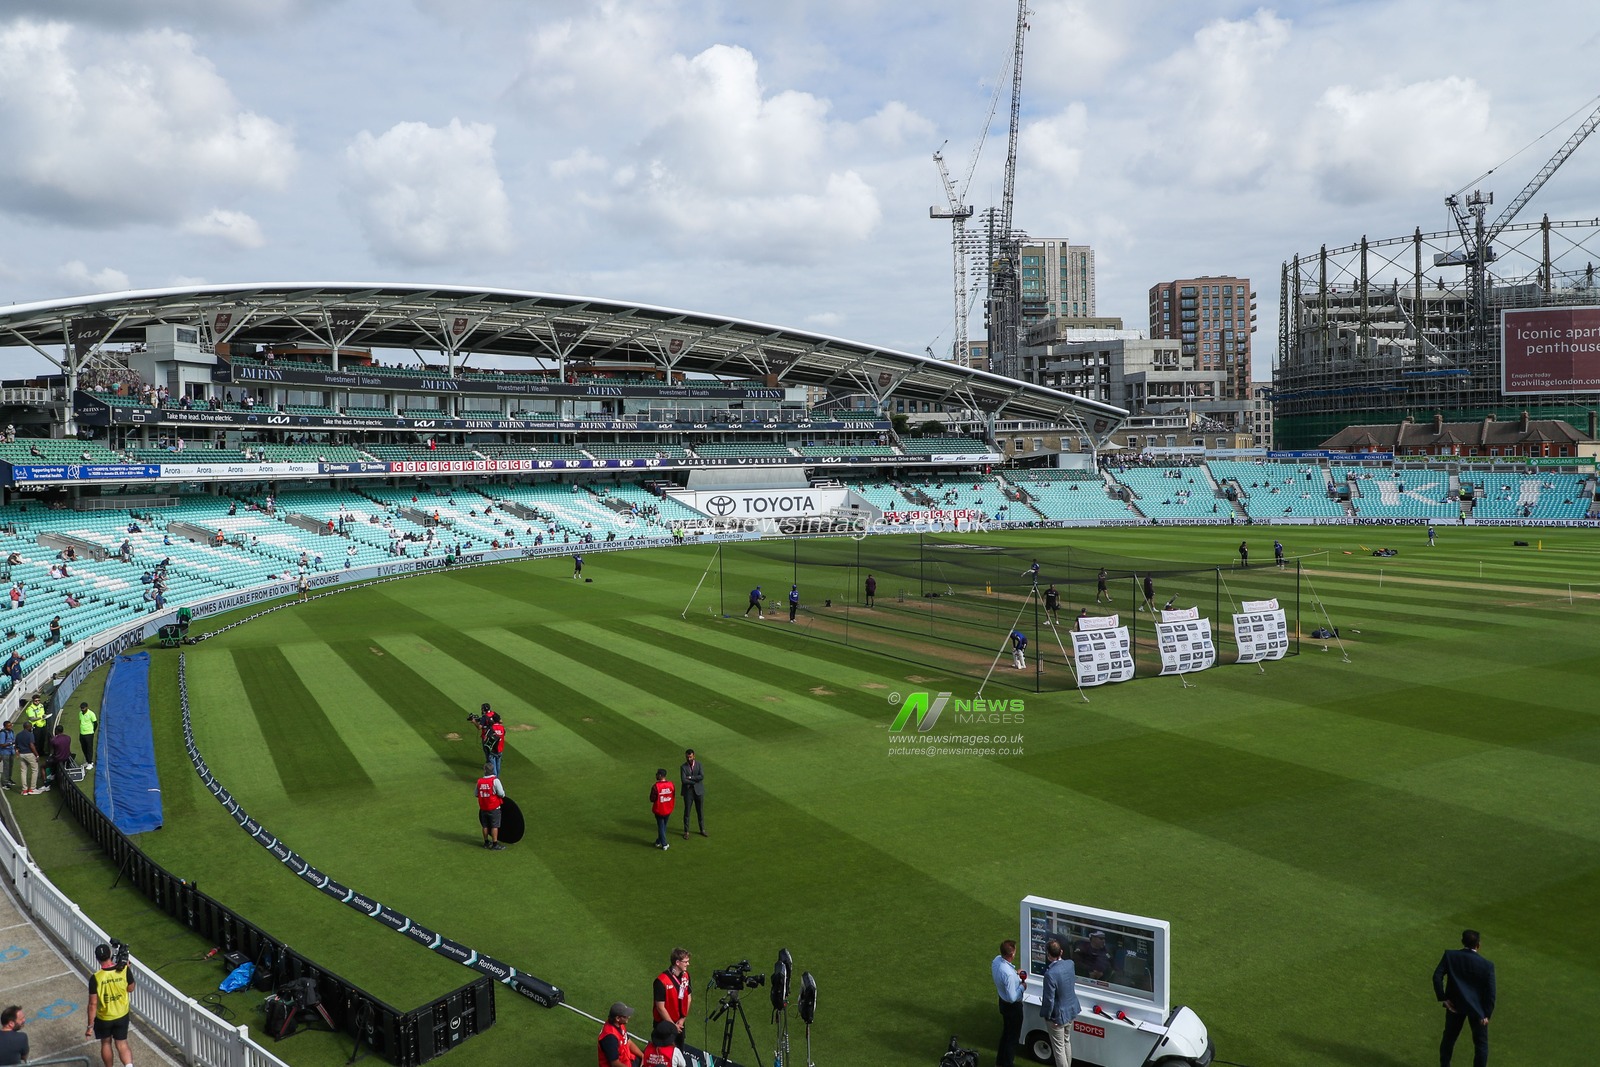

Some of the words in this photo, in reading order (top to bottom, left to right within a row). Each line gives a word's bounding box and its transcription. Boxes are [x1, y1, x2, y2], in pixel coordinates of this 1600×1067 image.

[1517, 327, 1562, 340] Iconic
[240, 367, 256, 379] JM
[258, 368, 283, 381] FINN
[324, 375, 356, 384] Investment
[361, 377, 382, 386] Wealth
[420, 380, 434, 390] JM
[436, 380, 459, 390] FINN
[496, 384, 526, 392] Investment
[586, 387, 599, 395] JM
[601, 387, 623, 395] FINN
[746, 390, 758, 398] JM
[760, 390, 781, 398] FINN
[353, 418, 364, 426] Drive
[392, 462, 401, 471] IG
[404, 462, 414, 471] IG
[416, 462, 426, 471] IG
[428, 462, 437, 471] IG
[440, 462, 449, 471] IG
[452, 462, 461, 470] IG
[463, 461, 472, 470] IG
[475, 461, 484, 470] IG
[487, 461, 496, 470] IG
[498, 461, 507, 469] IG
[510, 460, 519, 469] IG
[521, 461, 530, 469] IG
[538, 460, 553, 468] KP
[565, 460, 580, 468] KP
[592, 460, 607, 468] KP
[646, 459, 661, 467] KP
[164, 467, 180, 475] Arora
[743, 496, 815, 513] TOYOTA
[1353, 518, 1394, 526] ENGLAND
[1394, 518, 1431, 526] CRICKET
[713, 532, 744, 540] Rothesay
[521, 546, 564, 556] PROGRAMMES
[565, 542, 602, 552] AVAILABLE
[603, 540, 622, 549] FROM
[623, 539, 636, 547] £10
[647, 538, 660, 546] THE
[398, 562, 415, 574] ARE
[415, 558, 448, 571] ENGLAN
[455, 553, 484, 565] CRICKET
[191, 602, 217, 619] RAMMES
[217, 593, 250, 612] AVAILABLE
[250, 589, 268, 603] FROM
[269, 588, 280, 598] £10
[280, 586, 291, 597] ON
[306, 575, 340, 589] ONCOURSE
[91, 640, 120, 669] ENGLAND
[120, 626, 145, 651] CRICKET
[352, 896, 374, 912] Rothesay
[409, 926, 434, 944] Rothesay
[478, 959, 507, 978] Rothesay
[1074, 1022, 1104, 1037] sports
